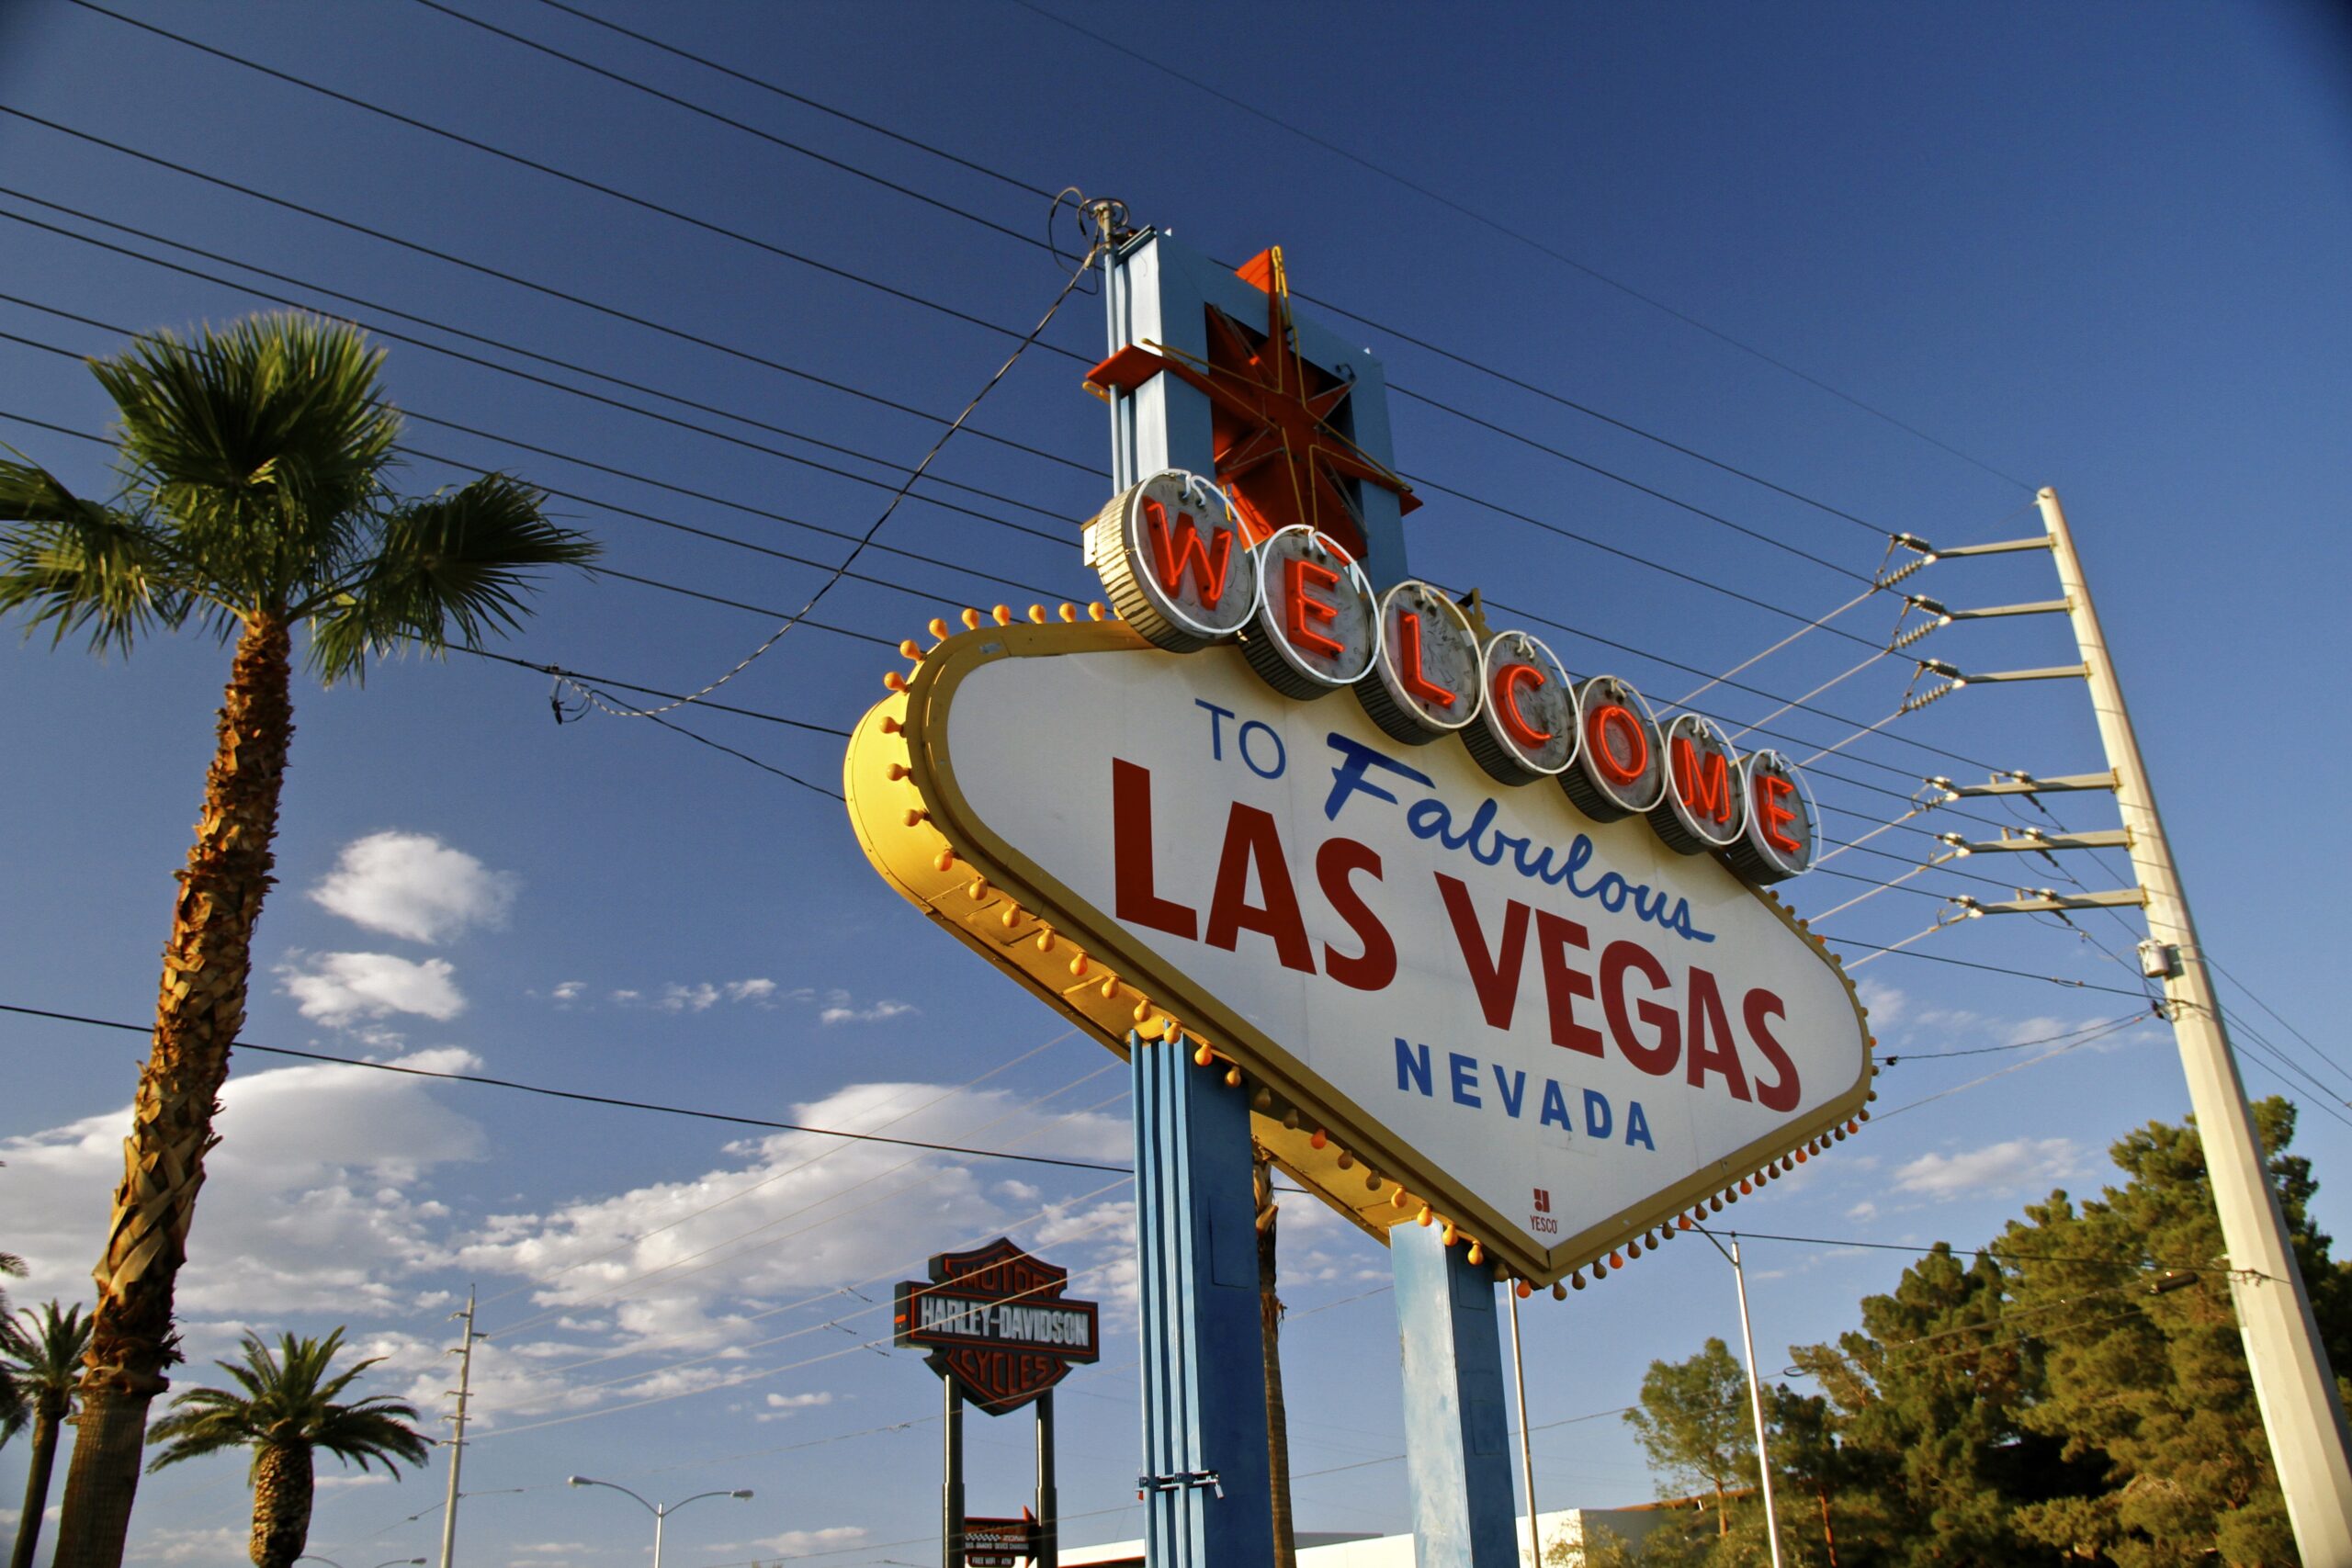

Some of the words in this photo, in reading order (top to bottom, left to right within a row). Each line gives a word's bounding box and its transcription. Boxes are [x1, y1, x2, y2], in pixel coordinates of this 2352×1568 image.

[1144, 496, 1801, 852] WELCOME
[1194, 698, 1287, 780] TO
[1324, 731, 1717, 943] Fabulous
[1112, 756, 1398, 992] LAS
[1433, 869, 1803, 1113] VEGAS
[1395, 1037, 1657, 1152] NEVADA
[1530, 1214, 1558, 1235] YESCO
[961, 1256, 1052, 1299] MOTOR
[921, 1296, 1089, 1347] HARLEY-DAVIDSON
[960, 1348, 1051, 1397] CYCLES
